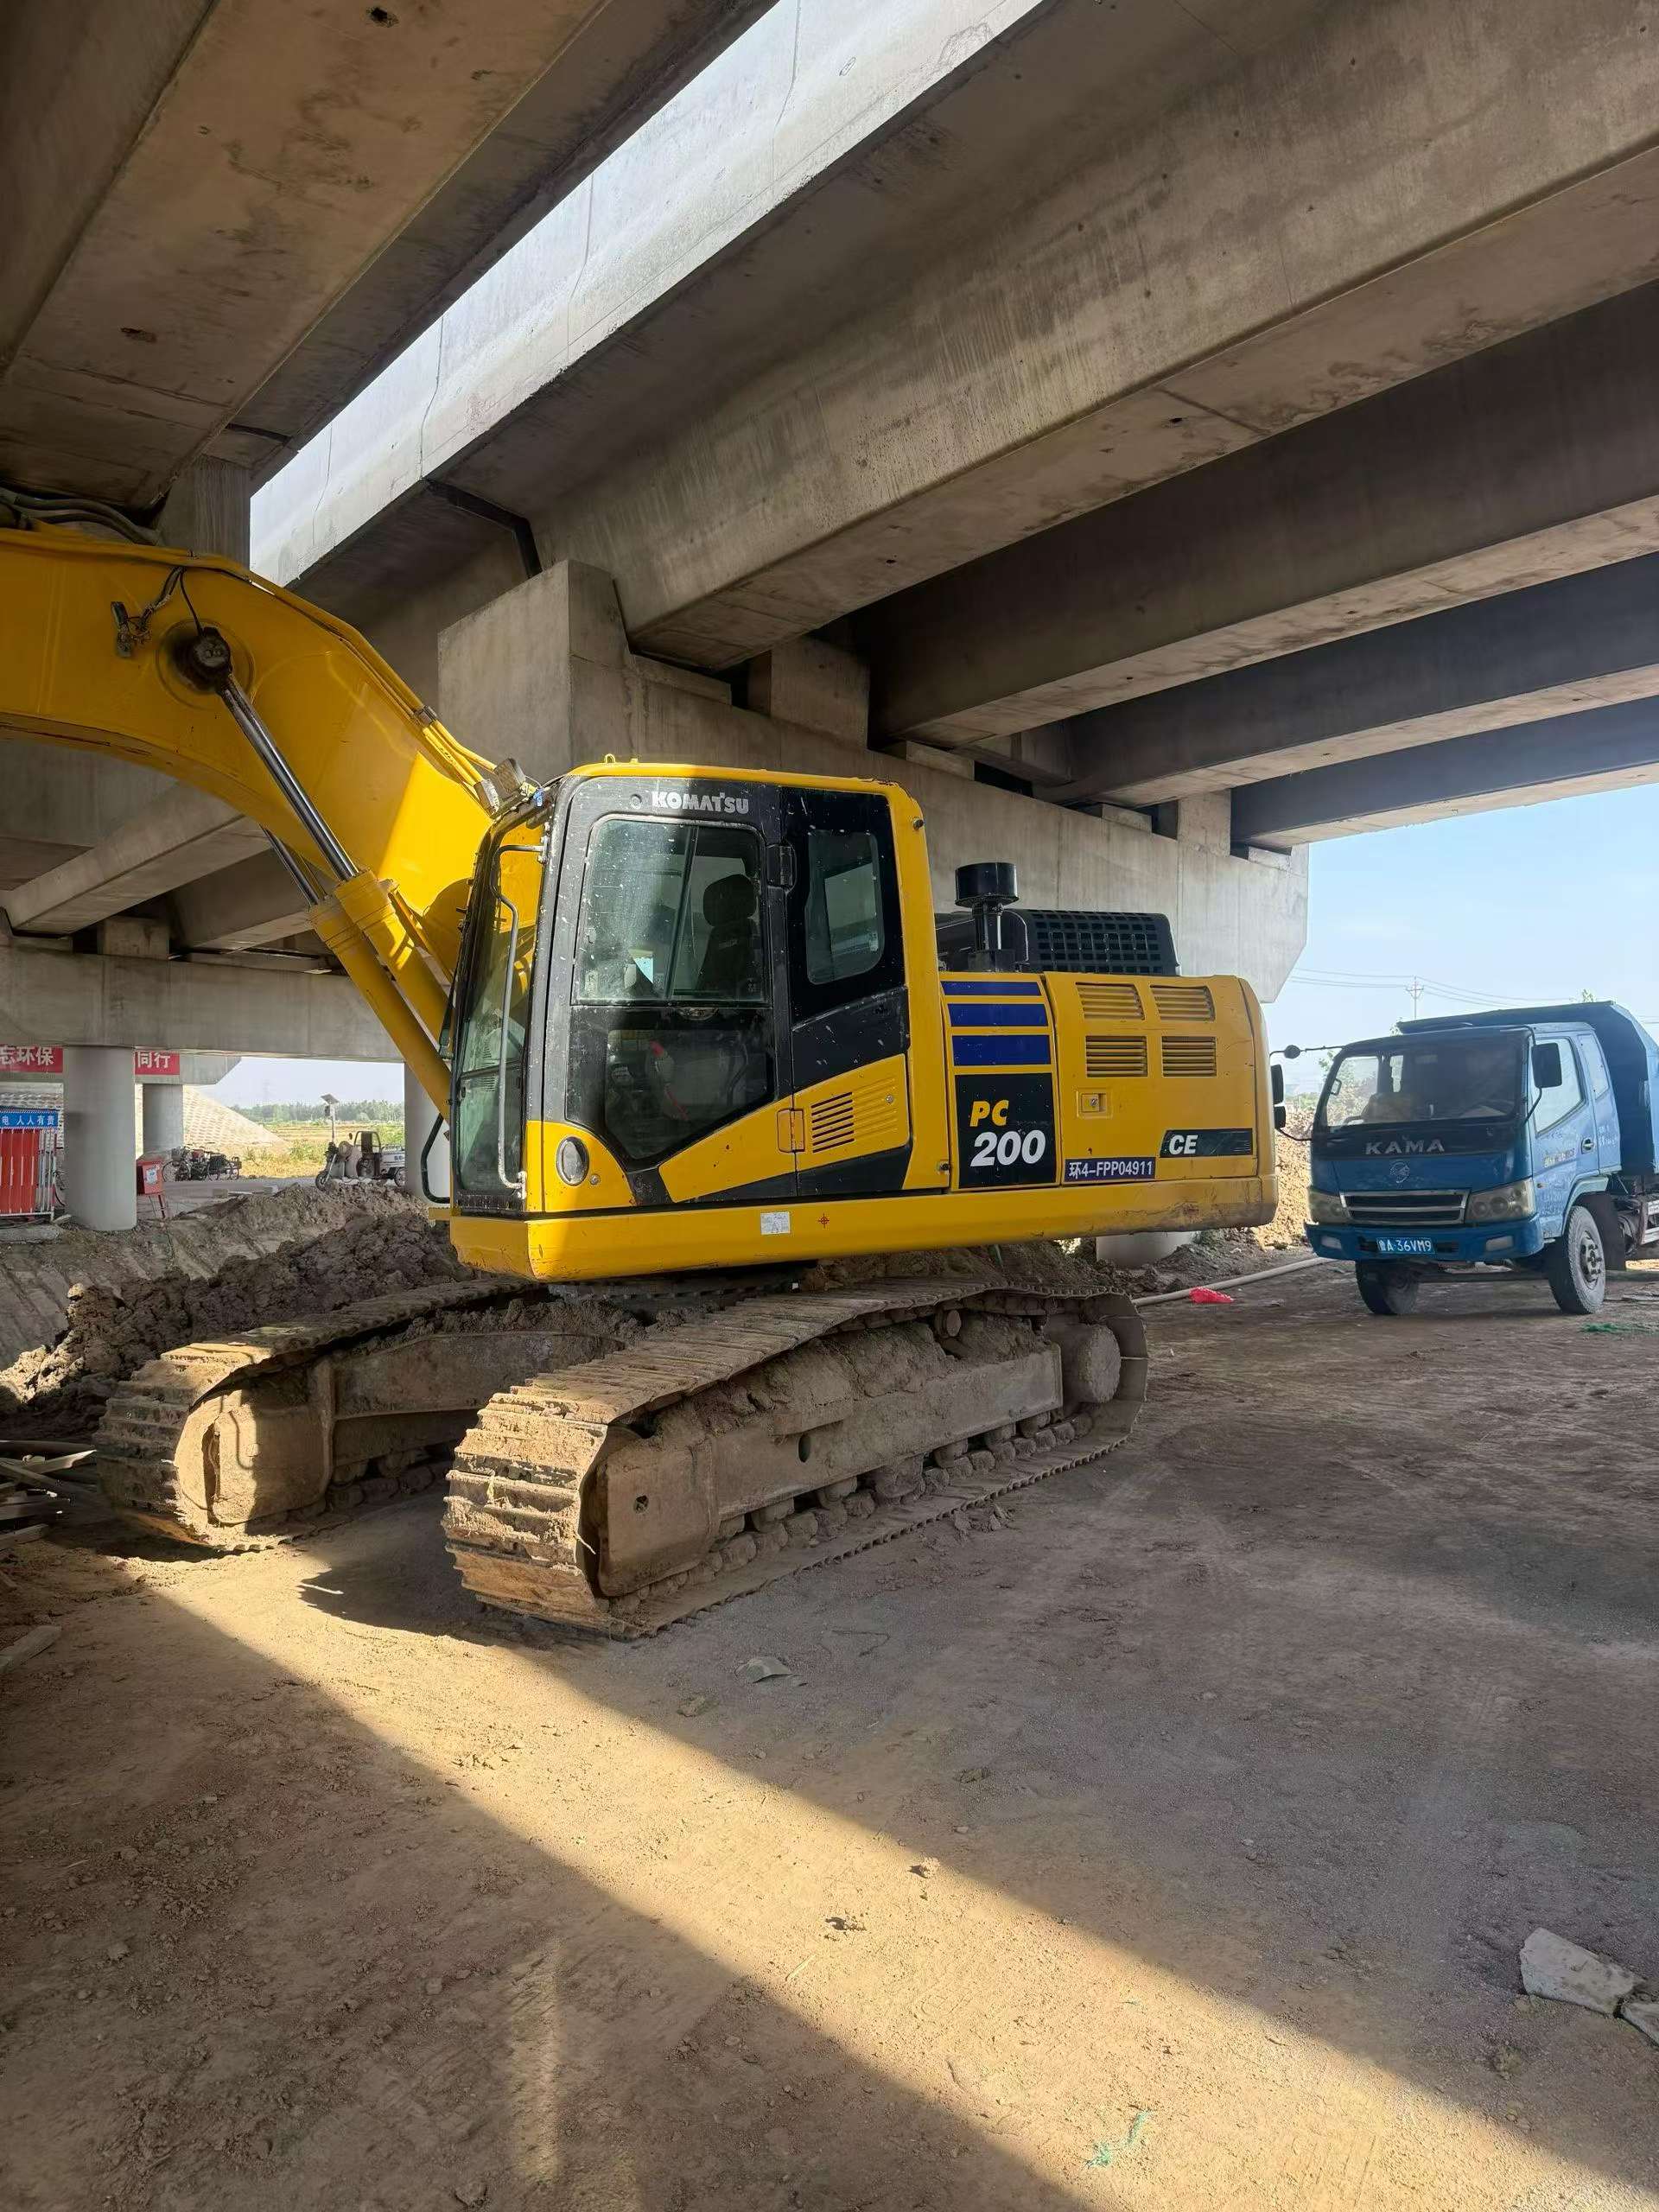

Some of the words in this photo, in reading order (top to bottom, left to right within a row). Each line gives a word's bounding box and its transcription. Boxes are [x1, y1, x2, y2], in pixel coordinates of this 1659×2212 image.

[652, 791, 749, 815] KOMATSU
[138, 1052, 170, 1068] 同行
[969, 1099, 1009, 1127] PC
[969, 1129, 1046, 1166] 200
[1168, 1135, 1198, 1155] CE
[1365, 1139, 1445, 1154] KAMA
[1069, 1160, 1154, 1179] 环4-FPP04911
